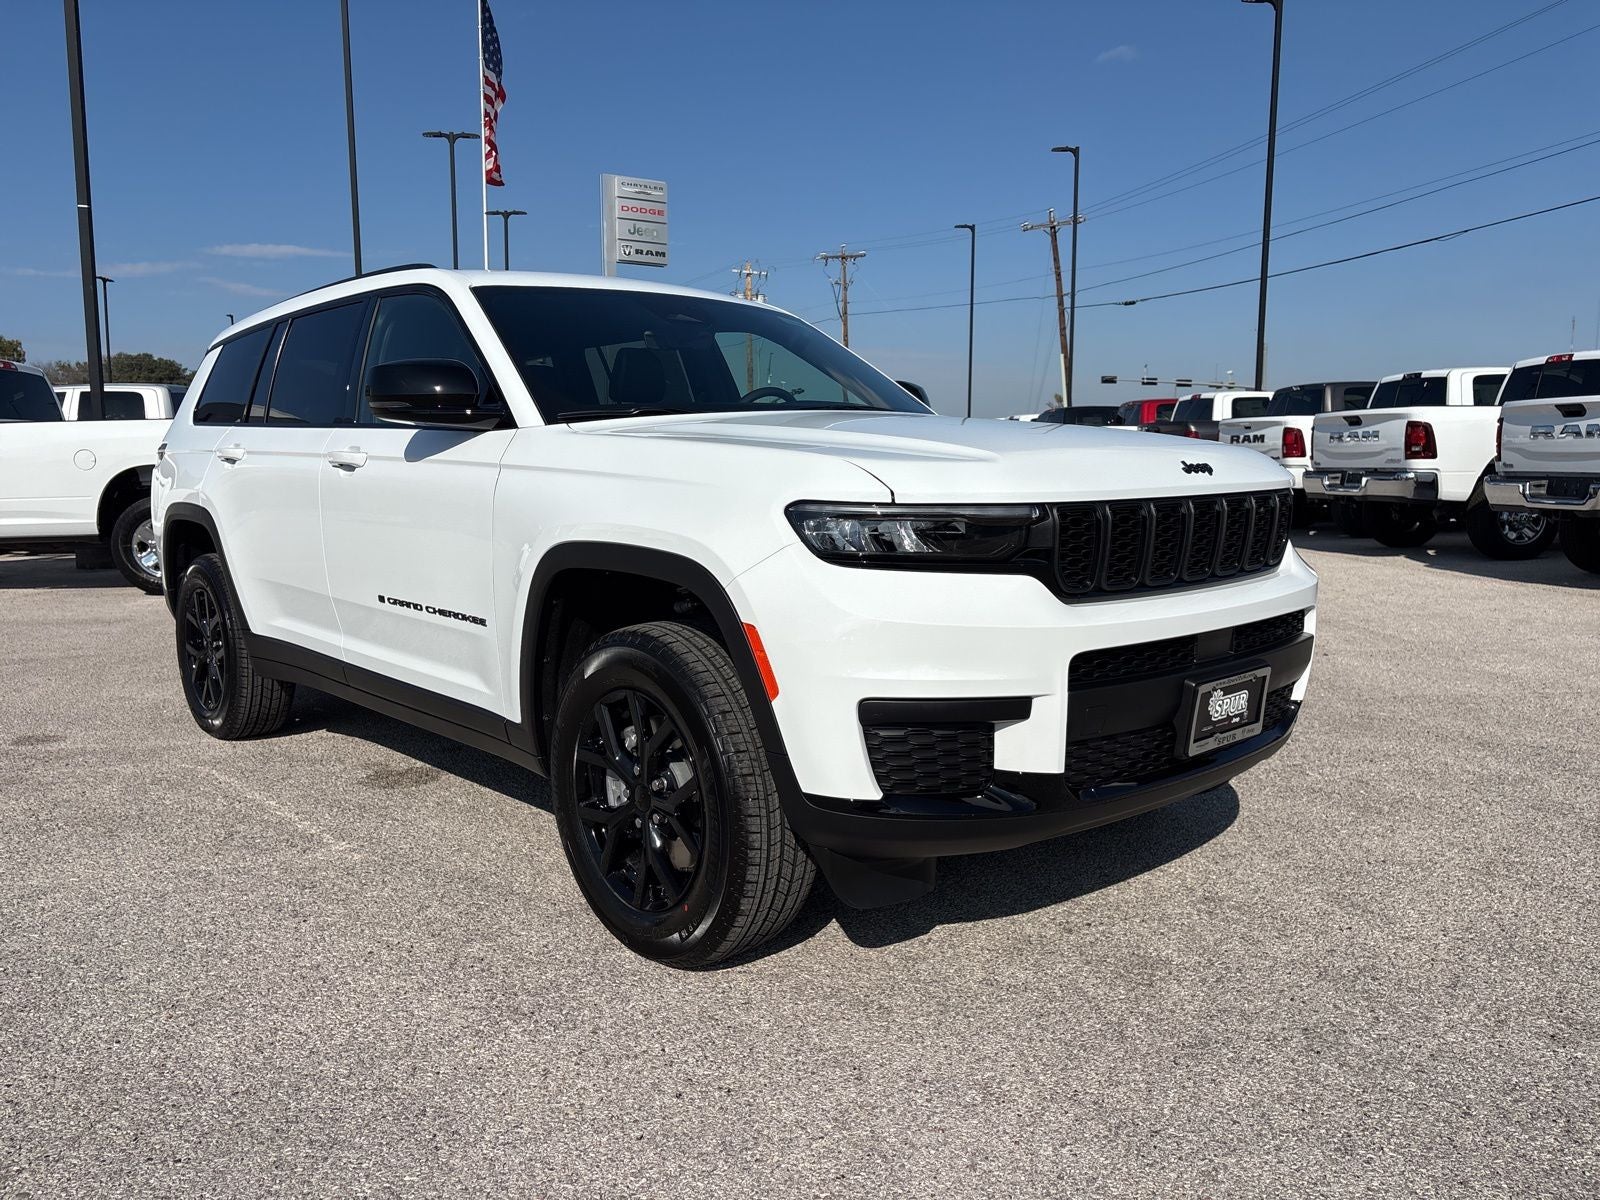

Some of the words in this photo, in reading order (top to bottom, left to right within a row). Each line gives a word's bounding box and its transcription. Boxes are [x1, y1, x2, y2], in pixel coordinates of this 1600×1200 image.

[621, 181, 664, 191] CHRYSLER
[621, 205, 665, 217] DODGE
[628, 223, 660, 240] Jeep
[635, 248, 666, 258] RAM
[1230, 434, 1265, 444] RAM
[1329, 430, 1380, 443] RAM
[1180, 460, 1214, 476] Jeep
[387, 597, 423, 612] GRAND
[425, 605, 488, 628] CHEROKEE
[1213, 693, 1247, 717] SPUR
